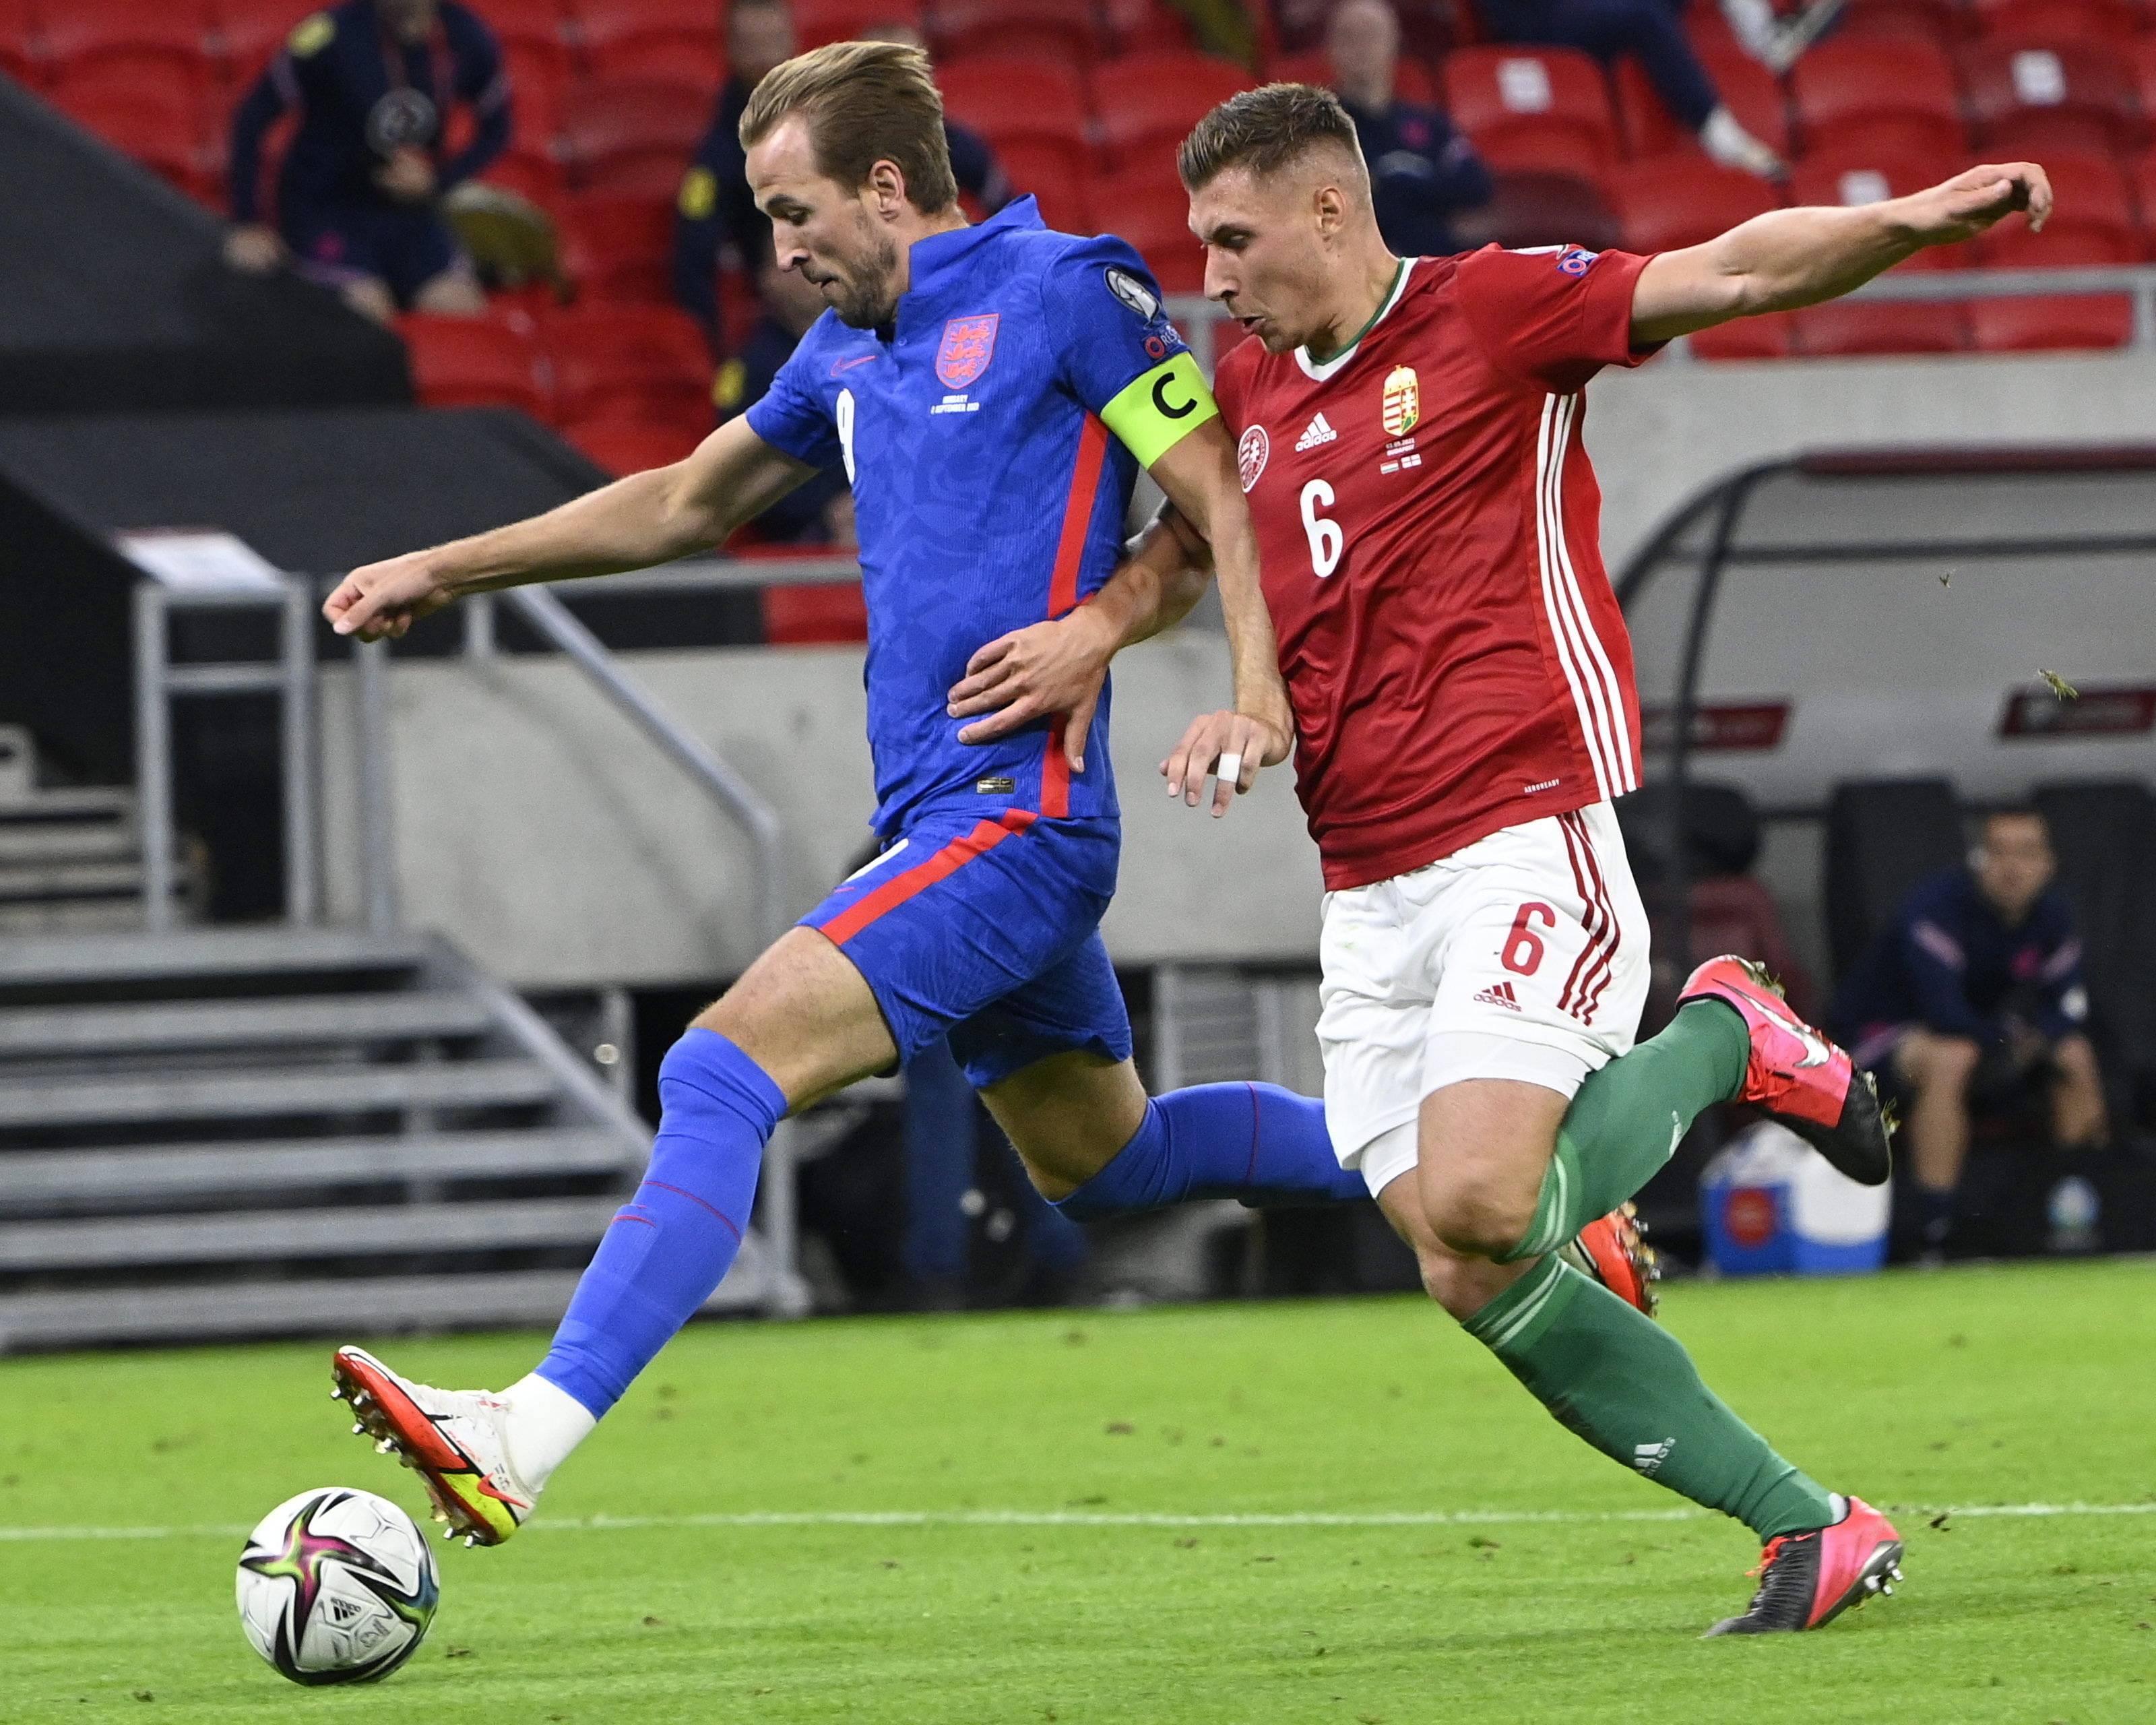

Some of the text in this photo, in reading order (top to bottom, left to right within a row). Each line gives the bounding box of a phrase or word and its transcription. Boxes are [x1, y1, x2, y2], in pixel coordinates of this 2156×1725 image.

[1152, 372, 1197, 418] C
[1295, 429, 1337, 452] adidas
[1300, 479, 1343, 577] 6
[1501, 902, 1556, 976] 6
[1473, 993, 1522, 1012] adidas
